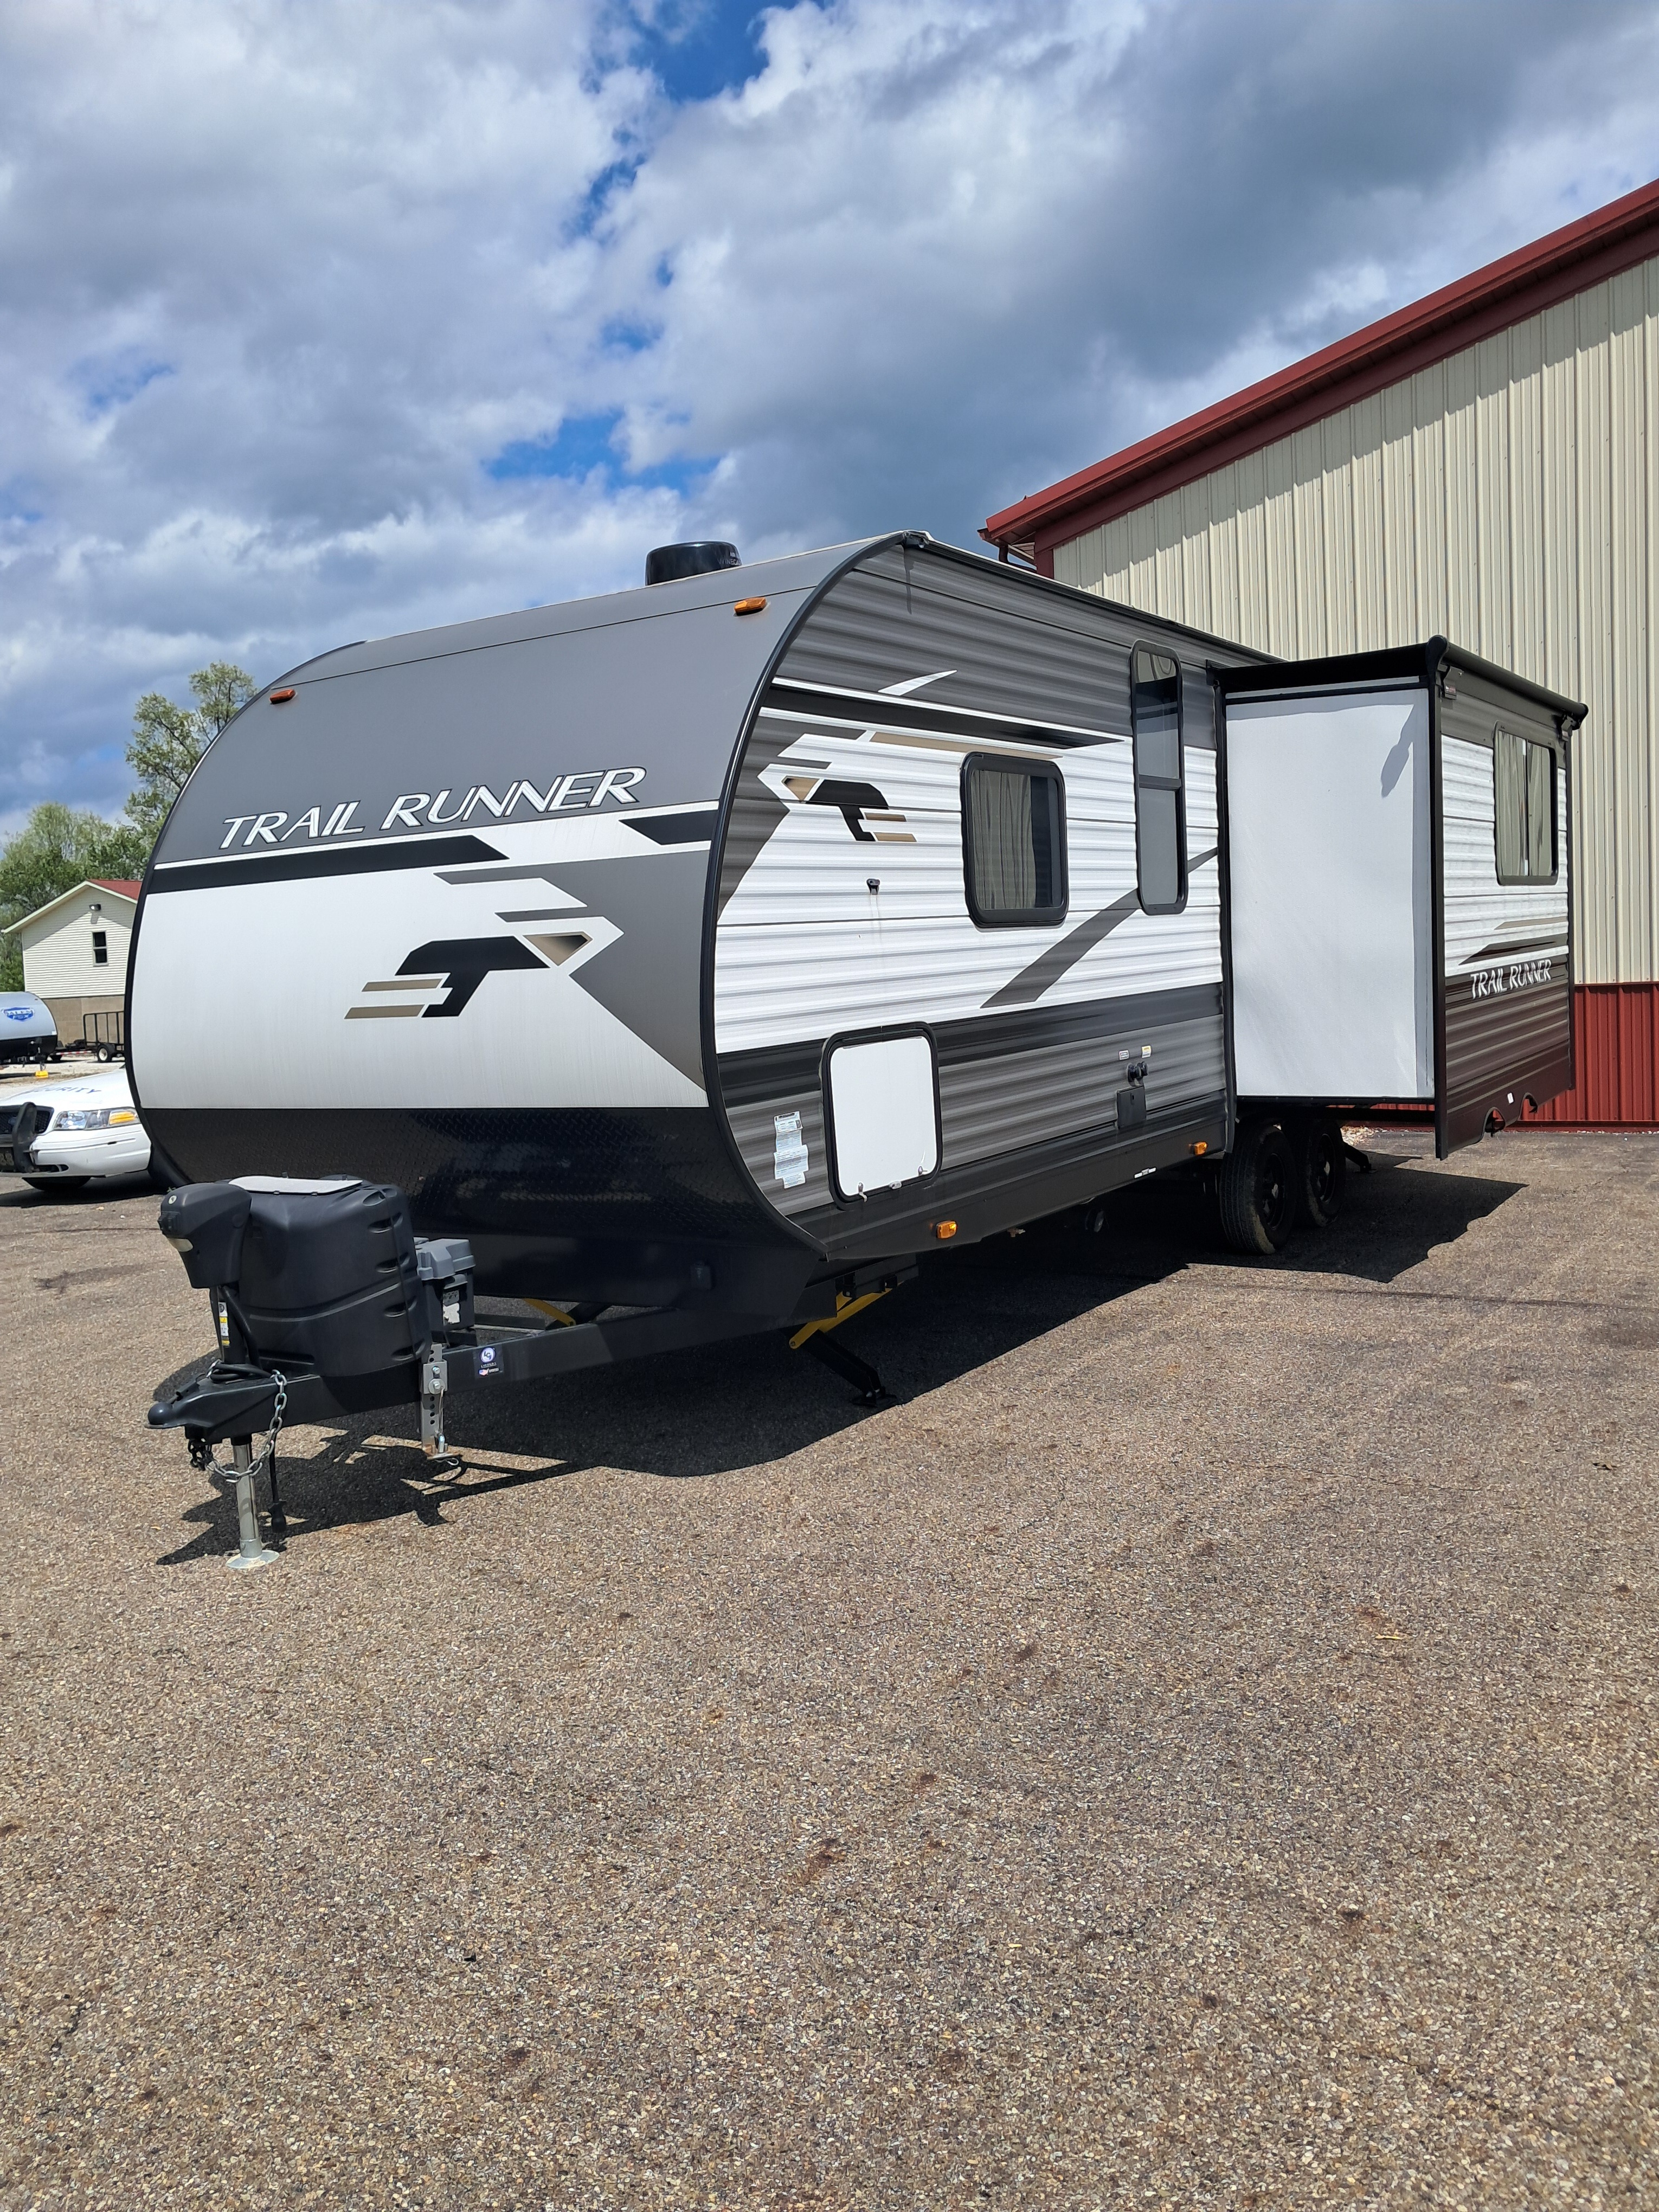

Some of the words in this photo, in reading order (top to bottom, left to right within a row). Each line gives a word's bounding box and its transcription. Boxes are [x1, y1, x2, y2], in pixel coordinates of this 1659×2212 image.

[218, 800, 365, 850] TRAIL
[379, 766, 647, 831] RUNNER
[1470, 968, 1507, 1000] TRAIL
[1509, 959, 1552, 991] RUNNER
